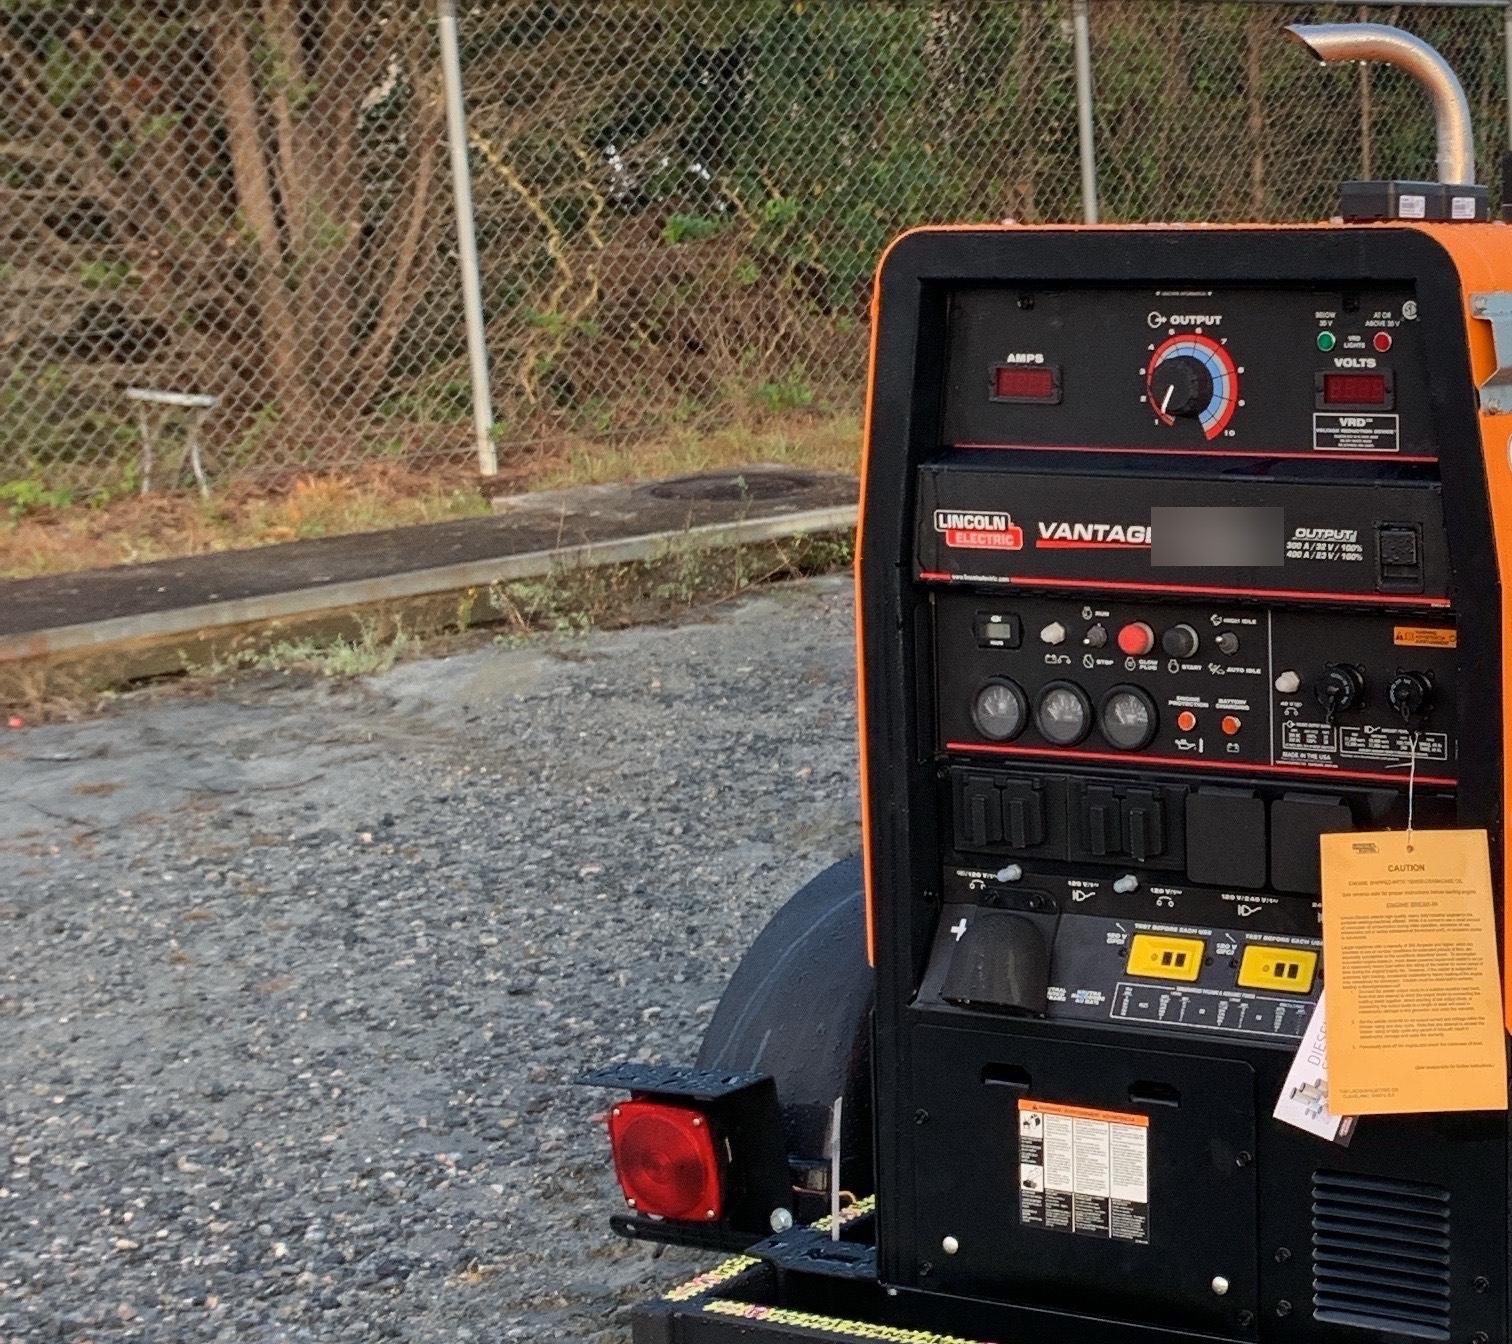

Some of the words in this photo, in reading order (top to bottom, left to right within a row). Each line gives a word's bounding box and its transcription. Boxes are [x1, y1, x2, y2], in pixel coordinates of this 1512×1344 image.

[1170, 315, 1222, 326] OUTPUT
[1148, 343, 1155, 351] 4
[1007, 353, 1044, 364] AMPS
[1334, 357, 1376, 368] VOLTS
[1223, 429, 1236, 437] 10
[938, 513, 1006, 530] LINCOLN
[955, 533, 1014, 546] ELECTRIC
[1294, 528, 1355, 541] OUTPUT
[1327, 543, 1334, 551] V
[1387, 864, 1425, 872] CAUTION
